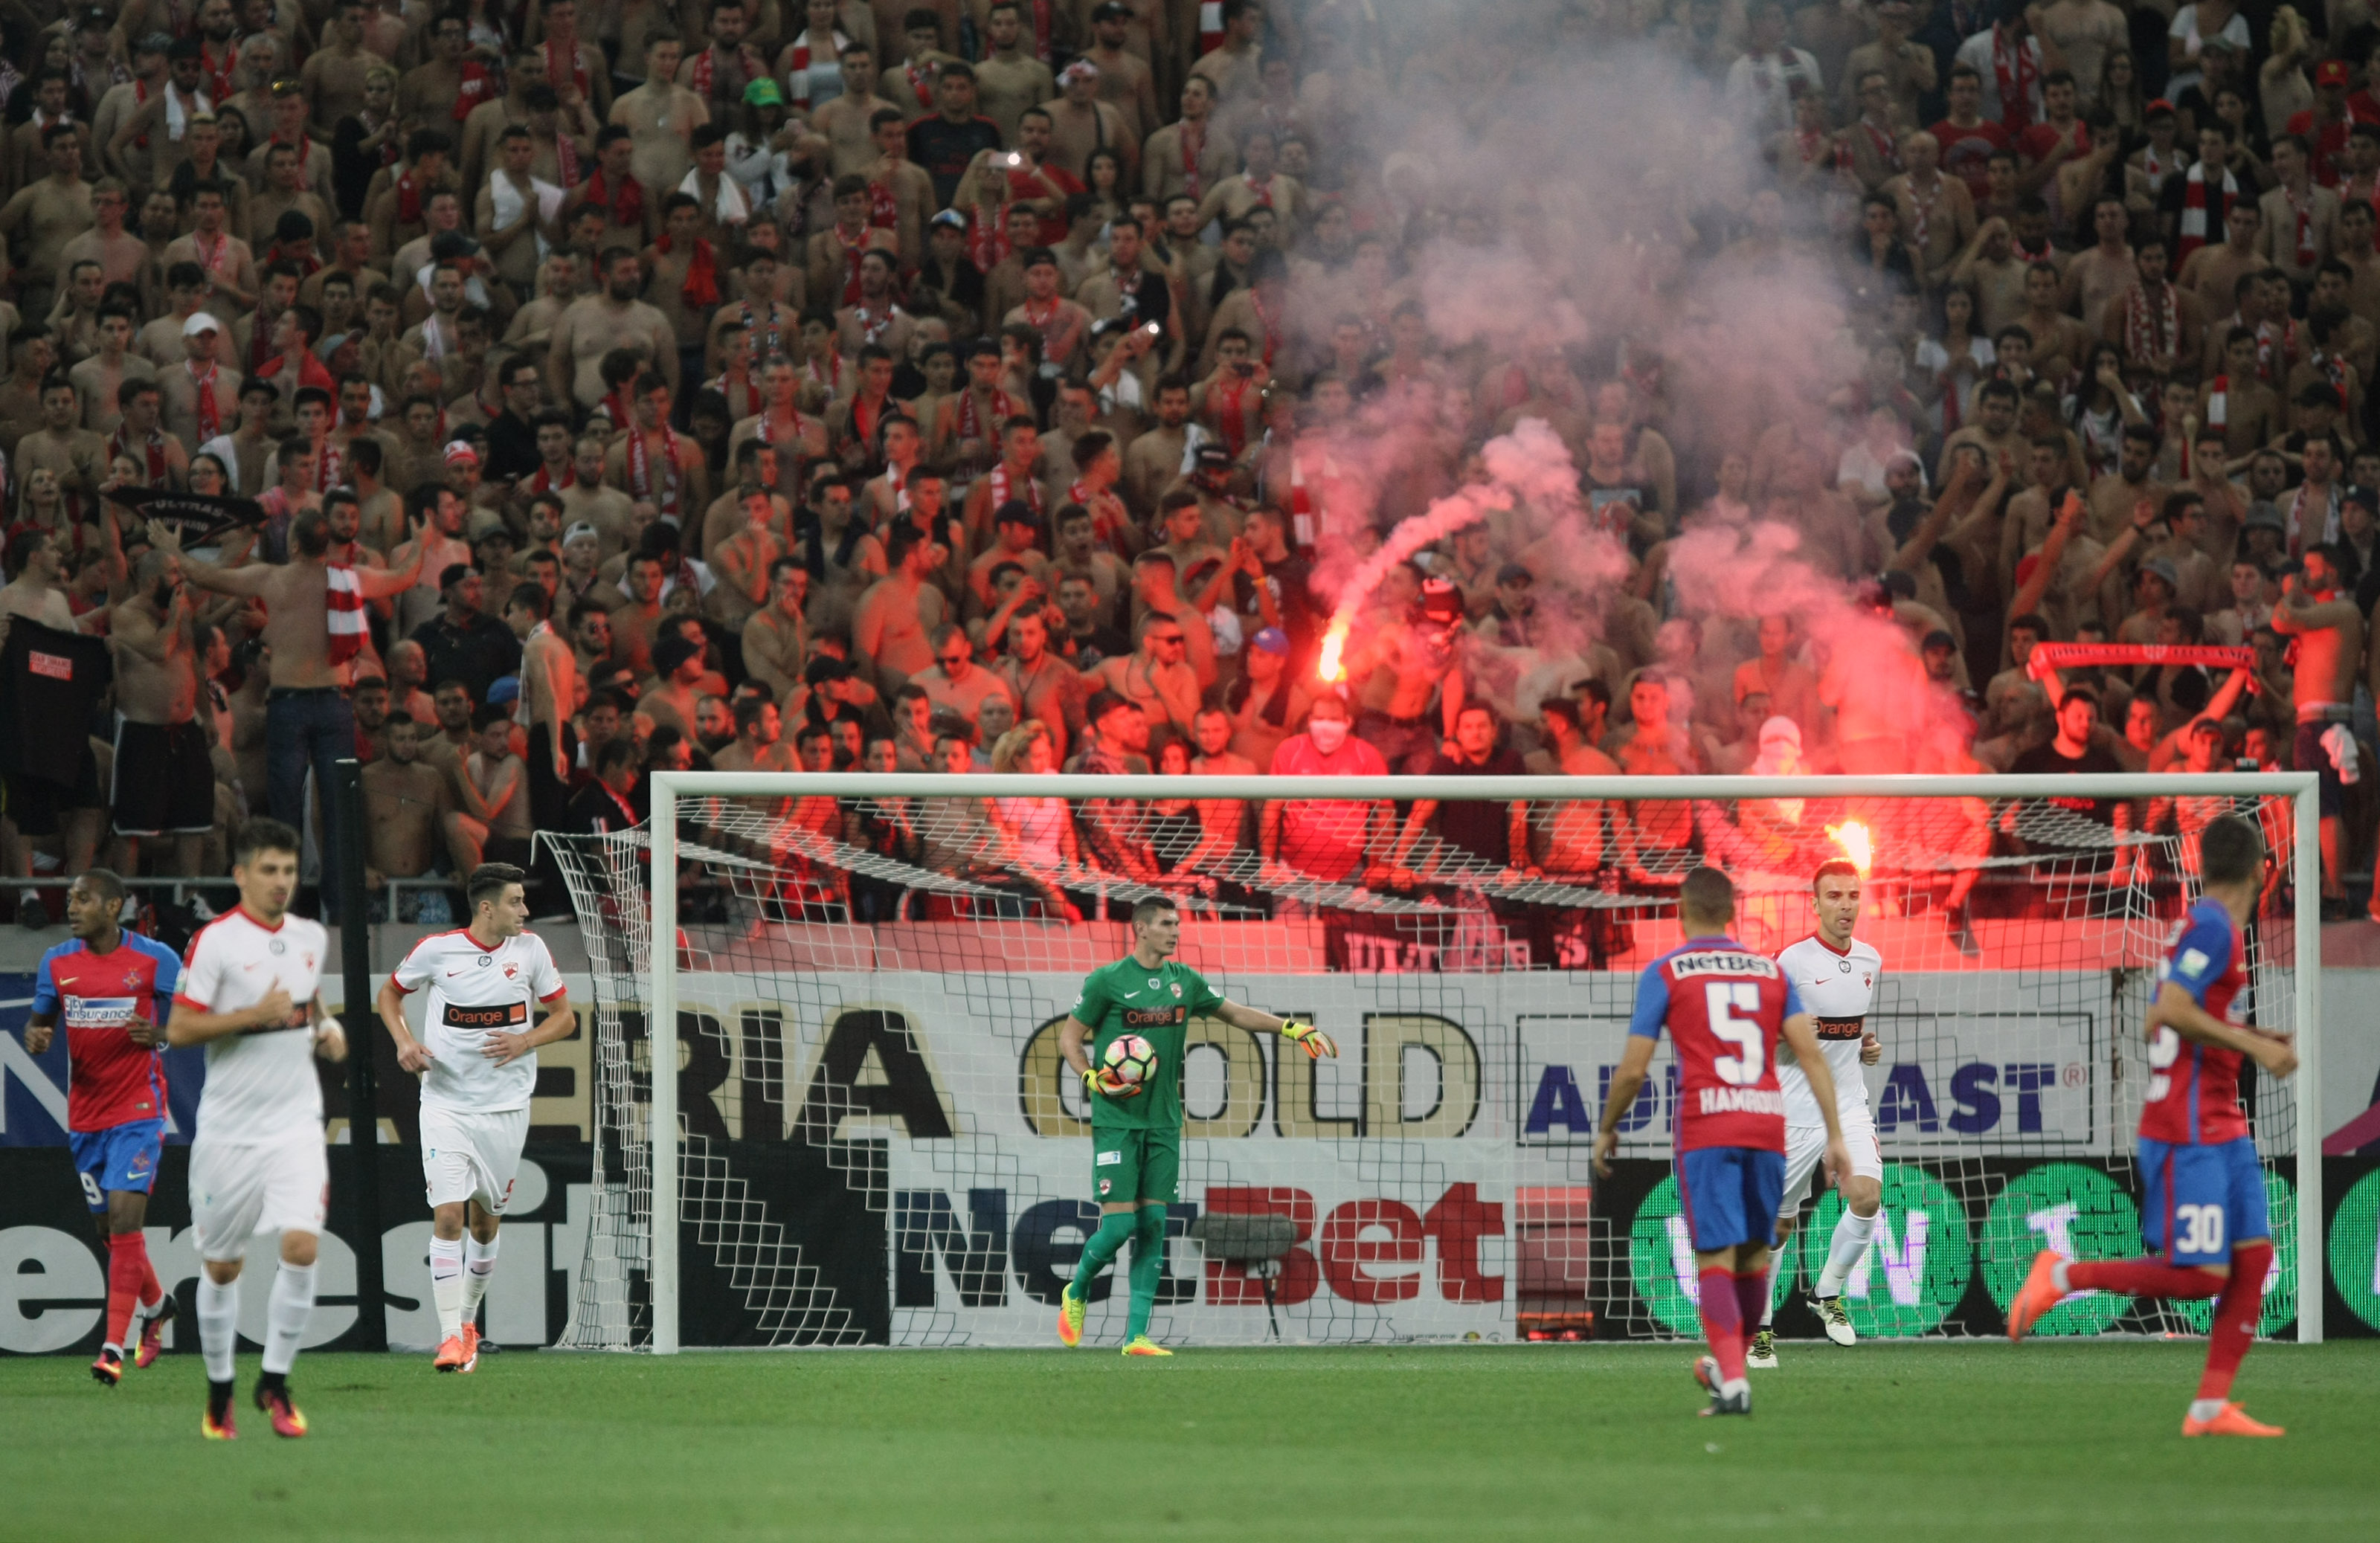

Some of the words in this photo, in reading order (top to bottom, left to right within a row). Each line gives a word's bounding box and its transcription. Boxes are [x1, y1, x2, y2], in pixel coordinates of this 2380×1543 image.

[1677, 956, 1773, 973] NetBet
[64, 996, 85, 1011] City
[448, 1008, 504, 1025] Orange
[1127, 1010, 1172, 1025] Orange
[1705, 982, 1764, 1085] 5
[2175, 1204, 2224, 1254] 30
